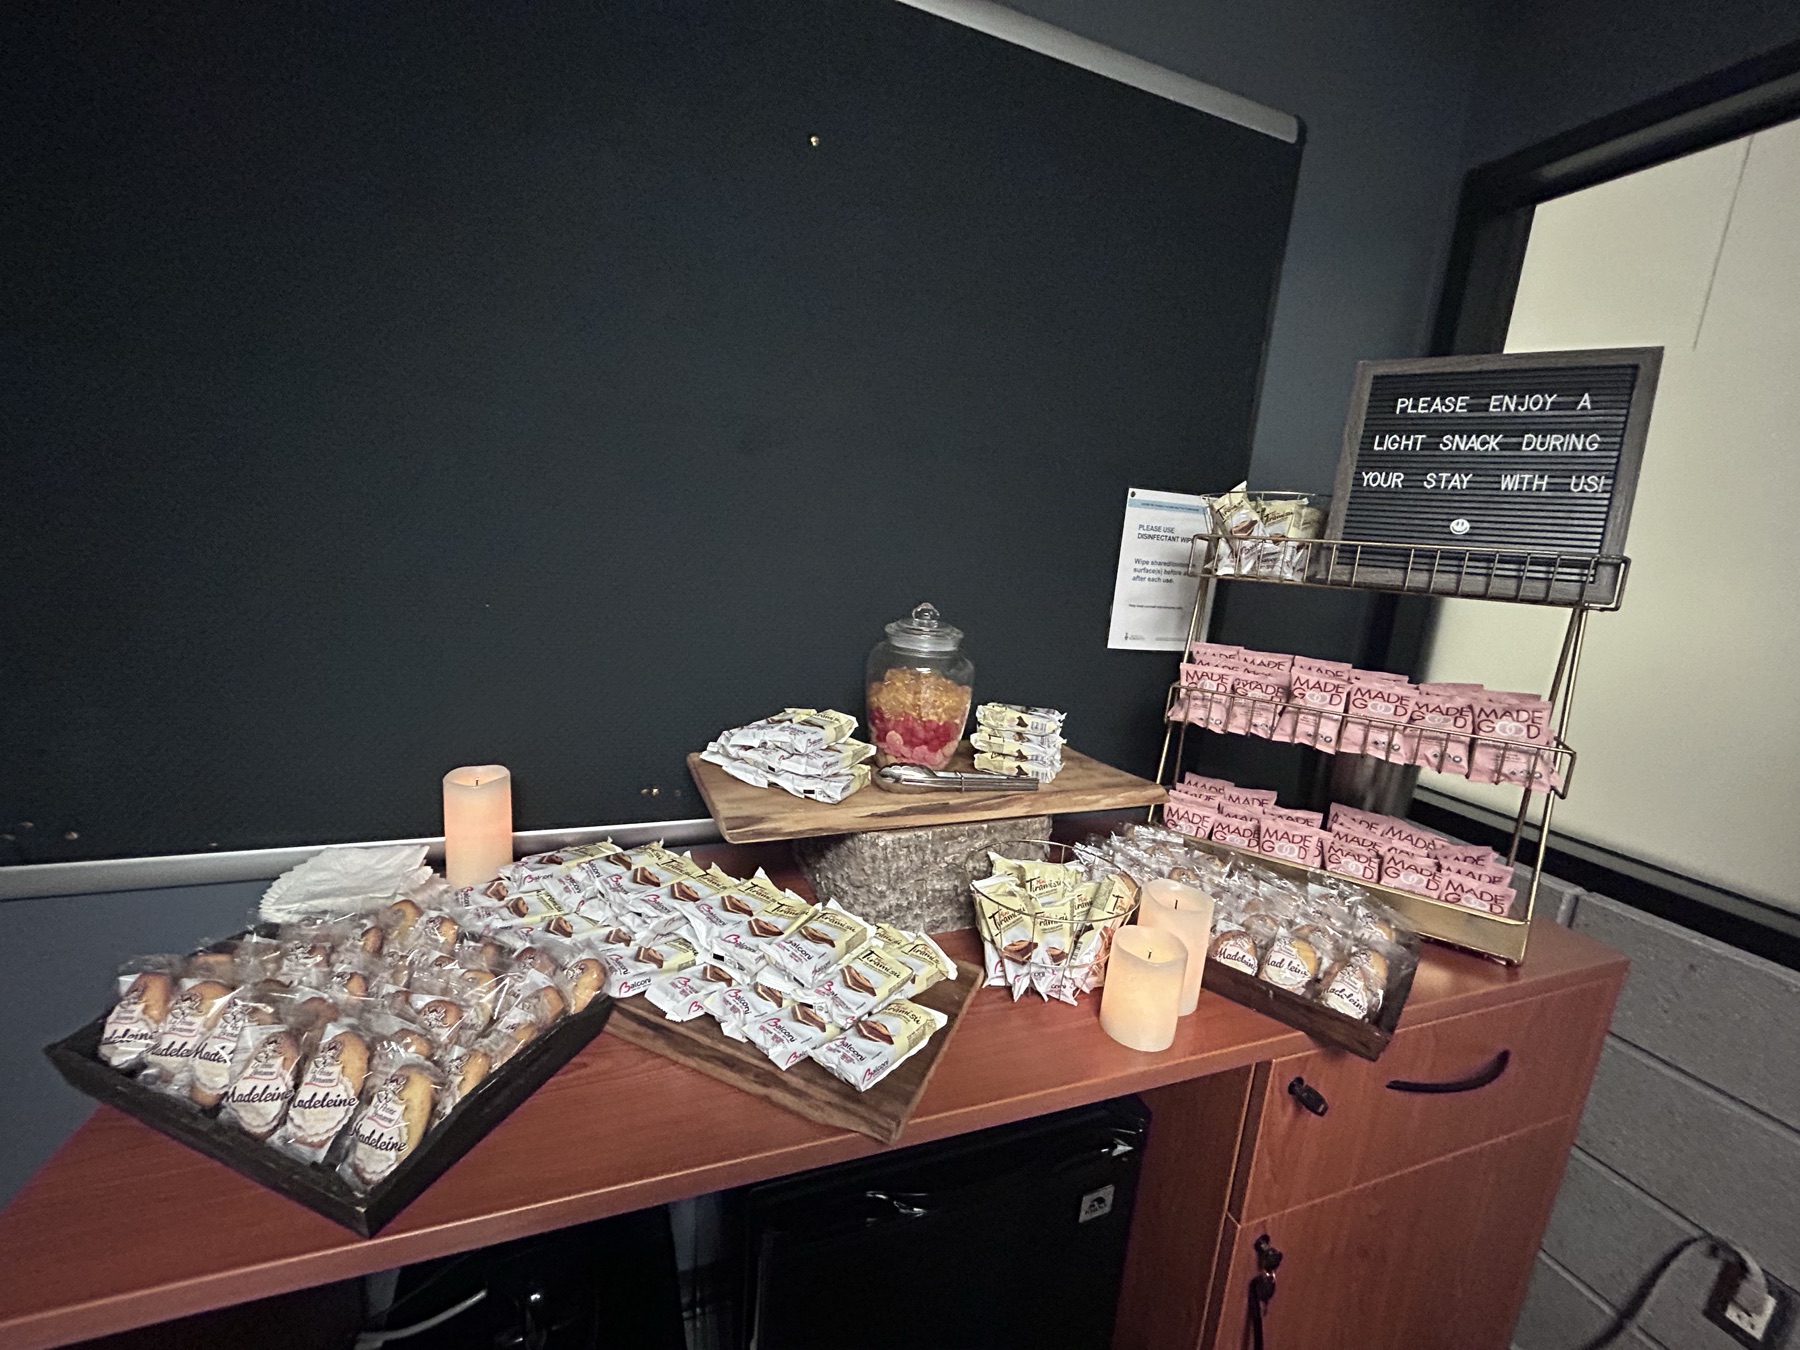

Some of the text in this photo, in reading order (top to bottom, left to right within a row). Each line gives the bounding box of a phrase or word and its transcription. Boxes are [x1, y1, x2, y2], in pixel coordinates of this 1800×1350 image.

[1396, 393, 1591, 414] PLEASE ENJOY A
[1373, 434, 1601, 451] LIGHT SNACK DURING
[1361, 472, 1404, 488] YOUR
[1423, 472, 1473, 489] STAY
[1500, 474, 1548, 491] WITH
[1137, 532, 1179, 543] DISINFECTANT
[1138, 524, 1162, 532] PLEASE
[1134, 558, 1149, 566] Wipe
[1186, 670, 1230, 685] MADE
[1293, 676, 1346, 694] MADE
[1239, 680, 1285, 697] MADE
[1292, 687, 1343, 706] GOOD
[1354, 687, 1411, 707] MADE
[1352, 697, 1408, 717] GOOD
[1415, 701, 1471, 717] MADE
[1477, 707, 1544, 725] MADE
[1410, 710, 1467, 729] GOOD
[1477, 719, 1540, 739] GOOD
[1166, 806, 1211, 828] MADE
[1214, 830, 1260, 848] GOOD
[1216, 822, 1260, 839] MADE
[1263, 828, 1313, 848] MADE
[1262, 840, 1308, 859] GOOD
[1328, 845, 1378, 869] MADE
[1328, 853, 1374, 880] GOOD
[1387, 856, 1442, 880] MADE
[1384, 866, 1440, 891] GOOD
[1446, 880, 1506, 906] MADE
[223, 1085, 292, 1104] Madeleine
[350, 1124, 408, 1152] Madeleine
